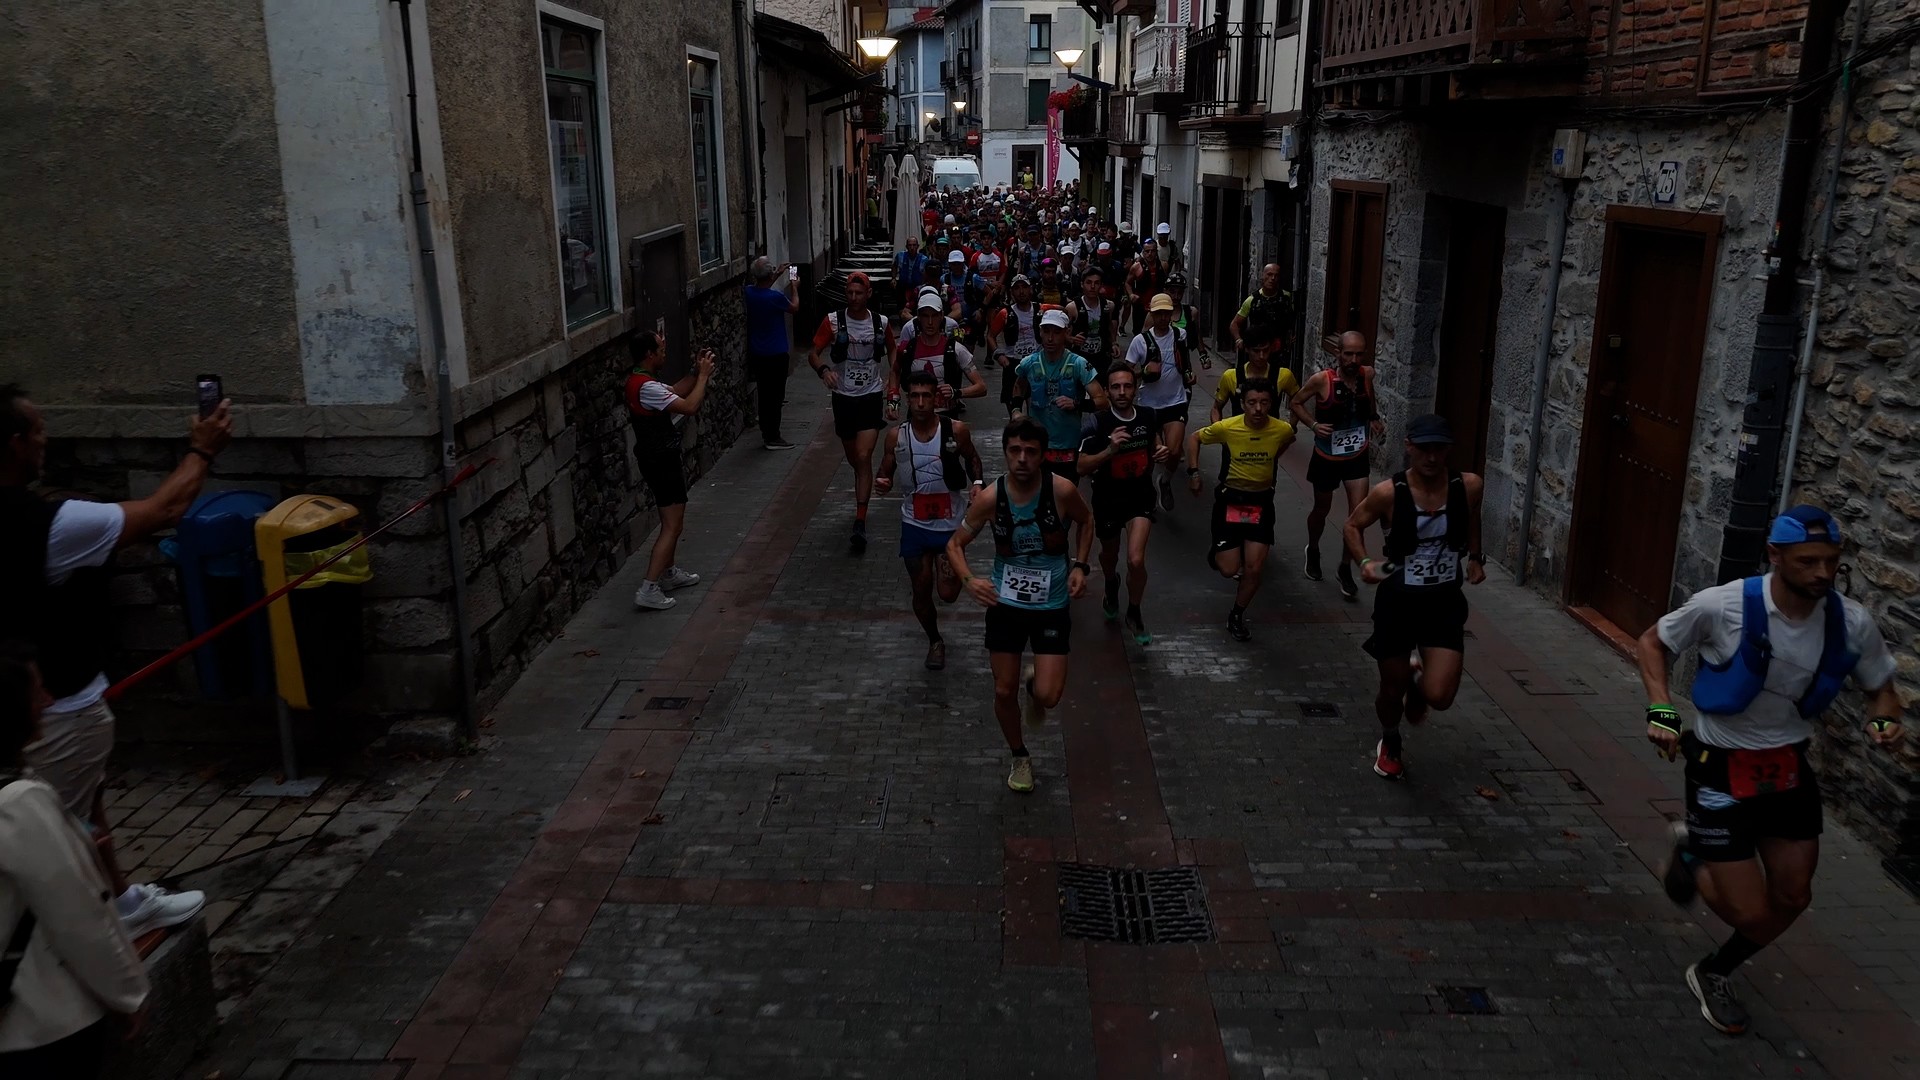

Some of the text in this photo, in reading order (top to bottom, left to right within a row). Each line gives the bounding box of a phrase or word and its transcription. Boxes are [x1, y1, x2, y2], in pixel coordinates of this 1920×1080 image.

[1659, 169, 1675, 194] 75
[1017, 347, 1033, 355] 226
[849, 371, 869, 381] 223
[1336, 434, 1360, 447] 232
[1413, 562, 1447, 576] 210
[1009, 577, 1041, 593] 225
[1750, 763, 1781, 781] 32
